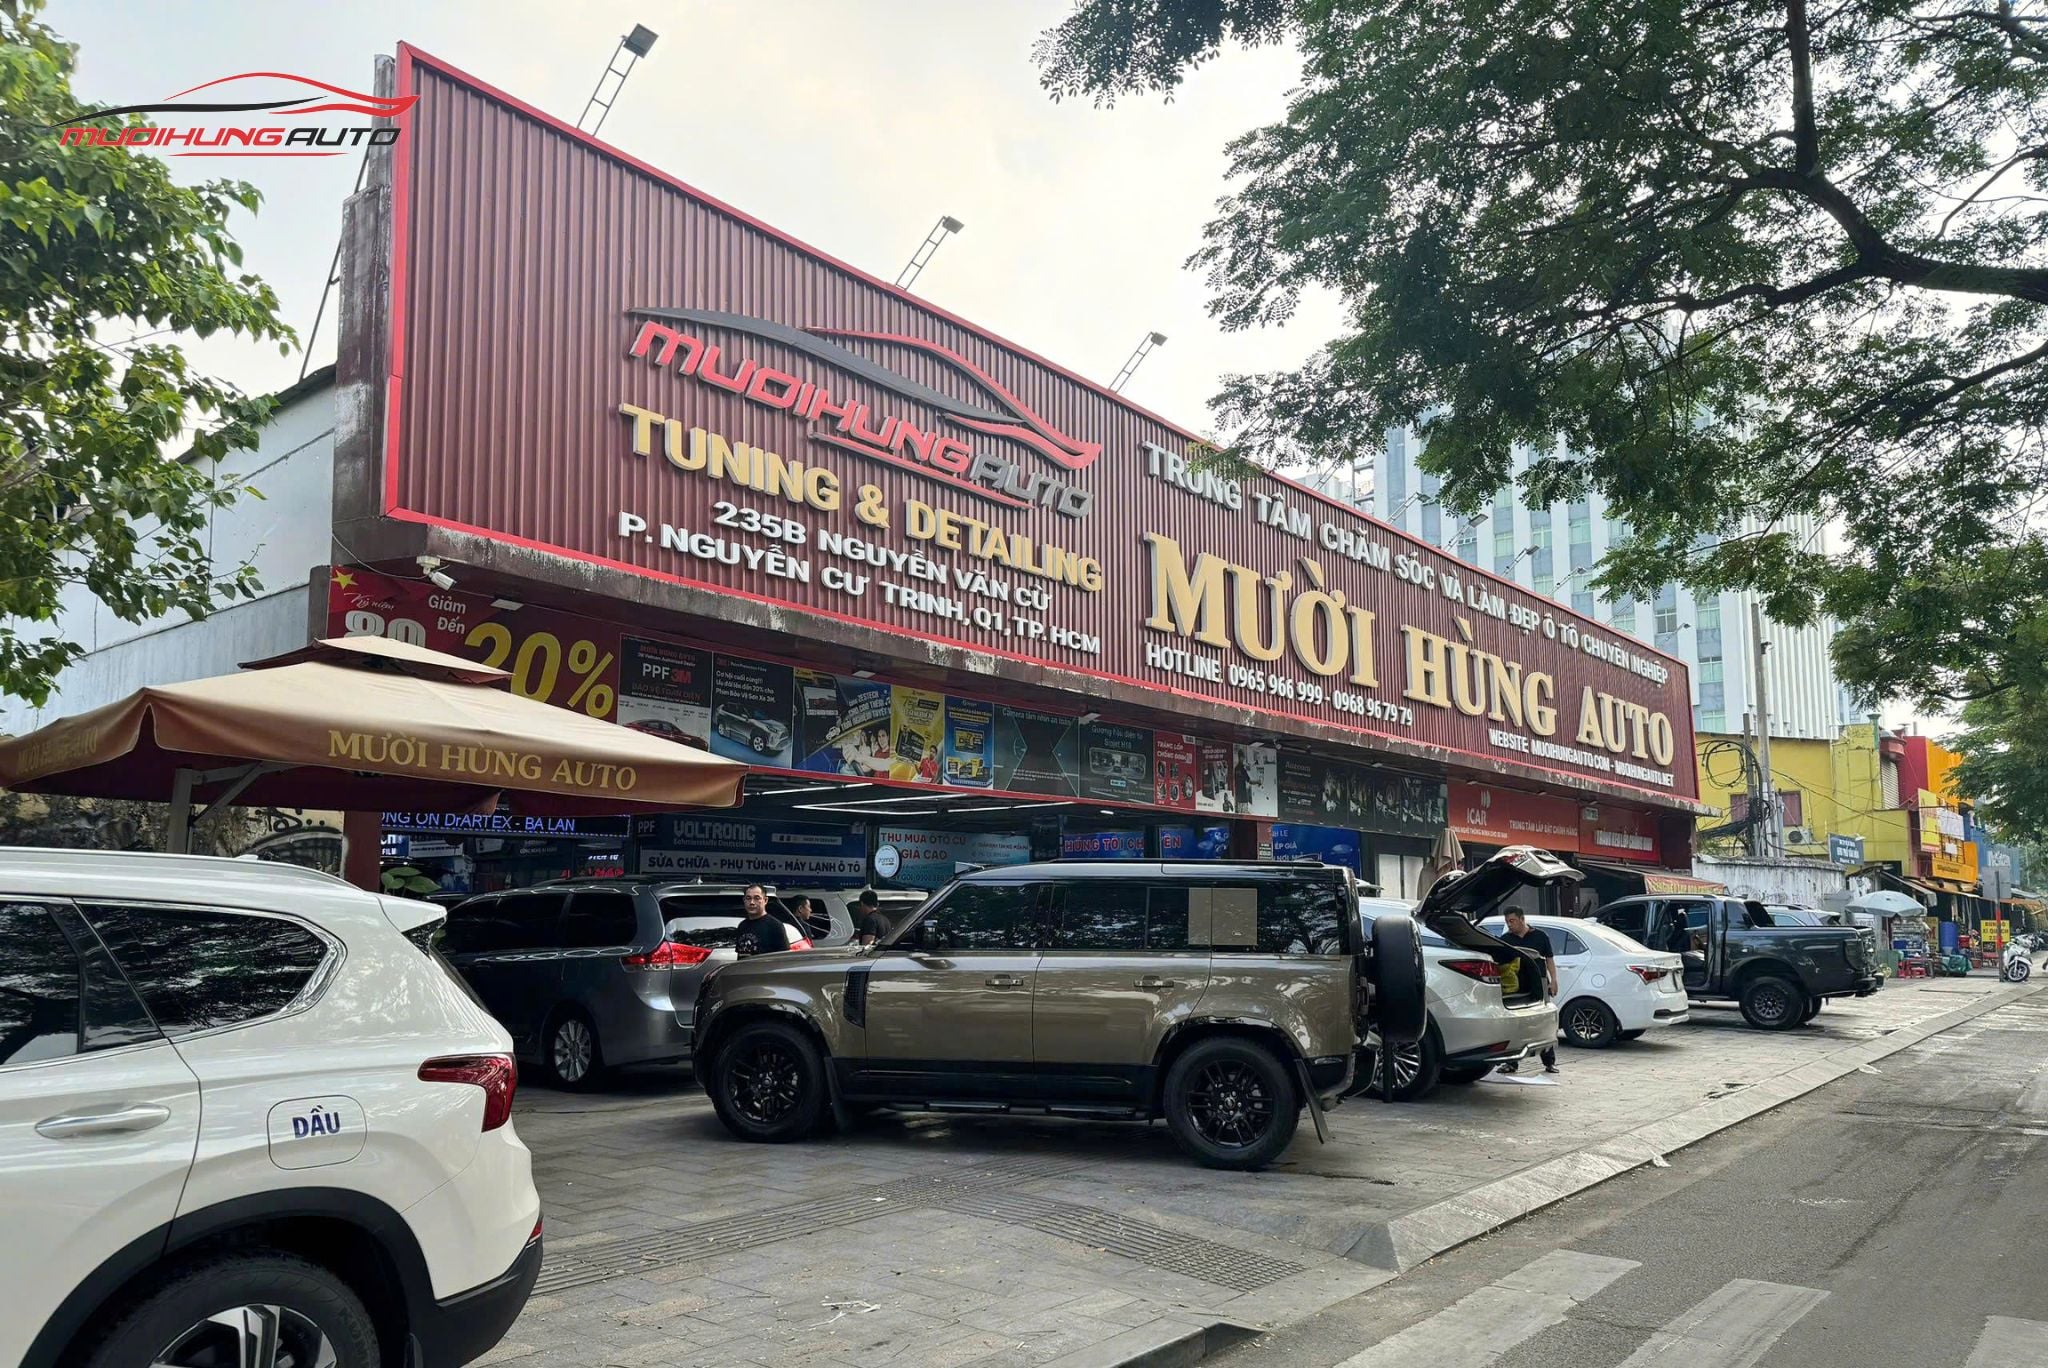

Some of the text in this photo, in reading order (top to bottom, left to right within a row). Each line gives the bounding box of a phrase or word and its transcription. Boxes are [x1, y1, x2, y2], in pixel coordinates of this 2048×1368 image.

[619, 402, 1102, 592] TUNING & DETAILING
[660, 523, 809, 583] NGUYỄN
[821, 566, 870, 596] CƯ
[713, 501, 806, 544] 235B
[954, 568, 1008, 601] VĂN
[1014, 584, 1052, 610] CỪ
[1142, 441, 1668, 688] TRUNG TÂM CHĂM SÓC VÀ LÀM ĐẸP Ô TÔ CHUYÊN NGHIỆP
[428, 595, 466, 614] Giảm
[437, 616, 465, 634] Đến
[1143, 531, 1673, 766] MƯỜI HÙNG AUTO
[465, 622, 614, 717] 20%
[642, 663, 670, 680] PPF
[1228, 664, 1265, 692] 0965
[1268, 674, 1294, 699] 966
[1297, 681, 1322, 704] 999
[1332, 690, 1364, 715] 0968
[328, 729, 637, 791] MƯỜI HÙNG AUTO
[444, 813, 513, 828] DrARTEX
[525, 817, 544, 830] BA
[548, 818, 575, 832] LAN
[638, 820, 756, 841] PPF VOLTRONIC
[1467, 808, 1487, 826] ICAR
[881, 832, 901, 842] THU
[904, 833, 927, 843] MUA
[648, 852, 673, 867] SỬA
[677, 855, 710, 868] CHỮA
[720, 858, 743, 872] PHỤ
[746, 857, 776, 871] TÙNG
[785, 859, 806, 871] MÁY
[809, 861, 836, 875] LẠNH
[923, 850, 947, 860] CAO
[292, 1105, 341, 1139] DẦU
